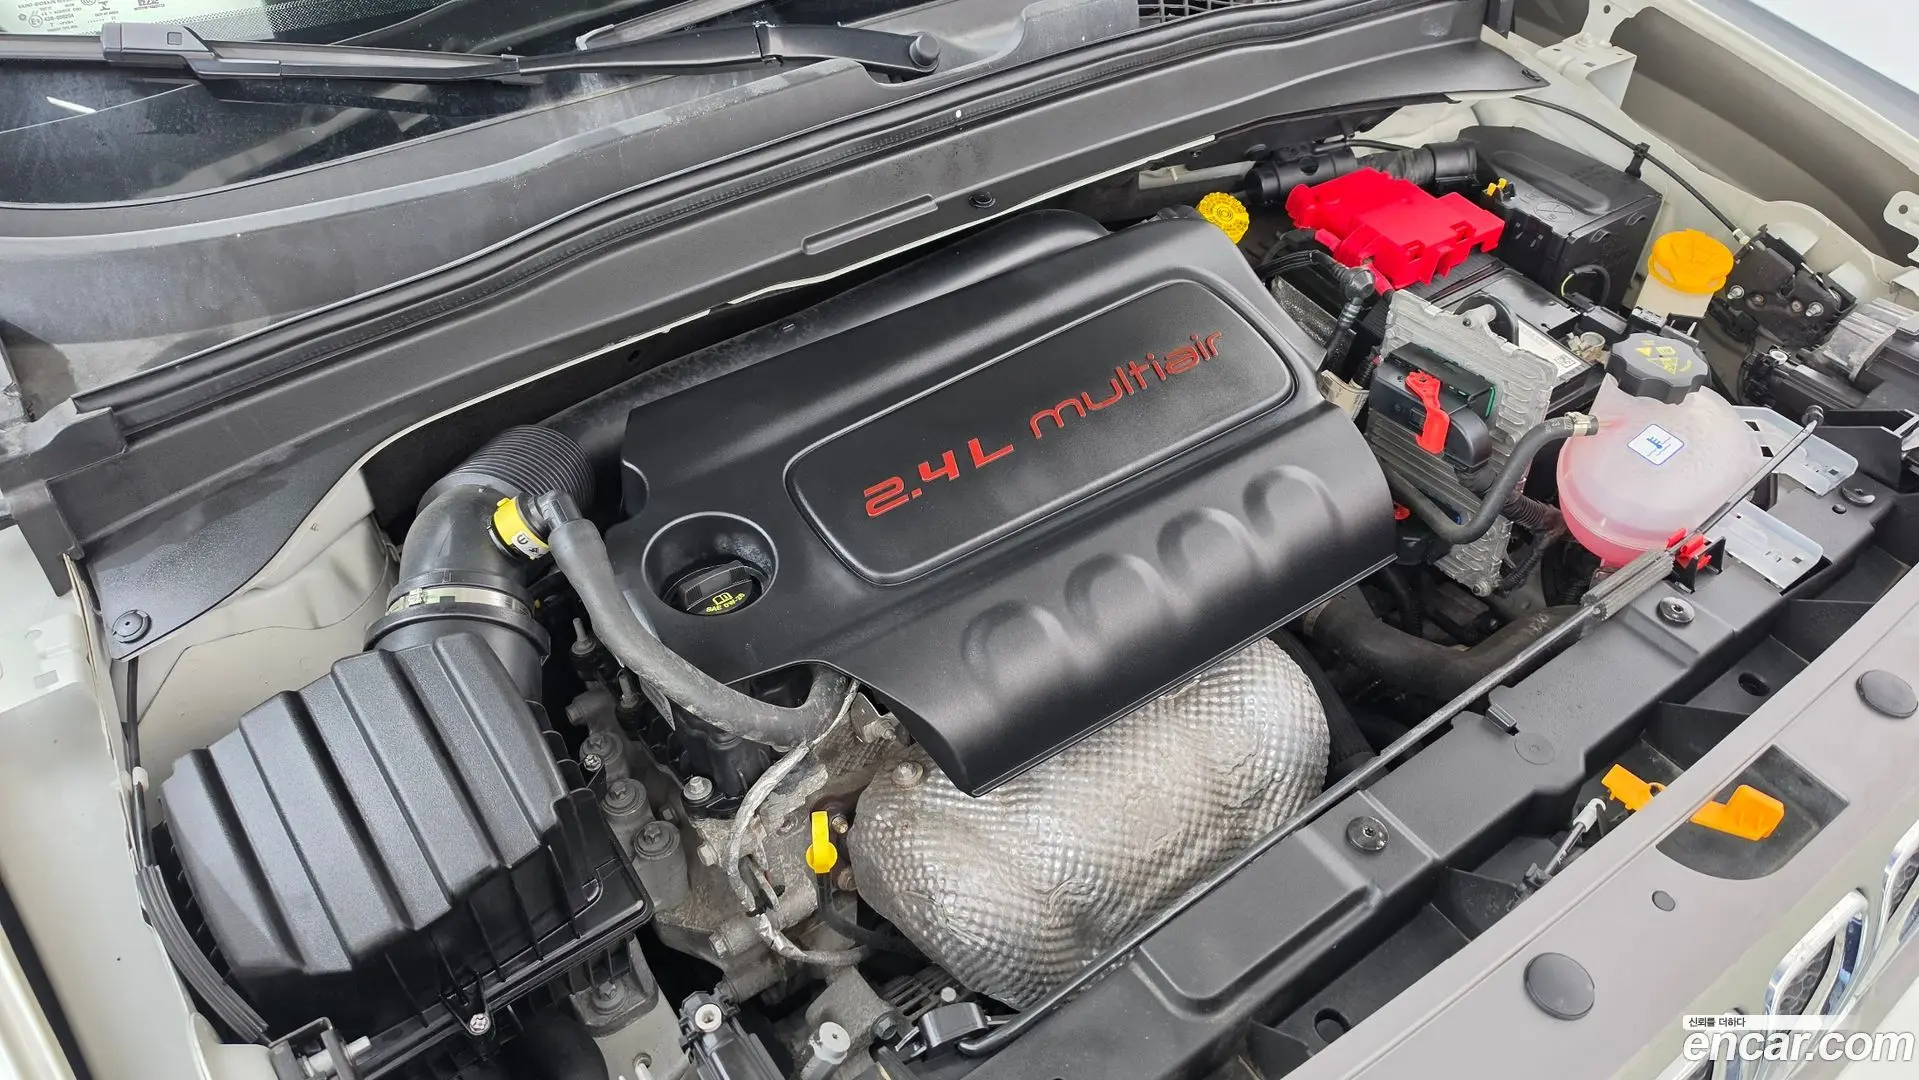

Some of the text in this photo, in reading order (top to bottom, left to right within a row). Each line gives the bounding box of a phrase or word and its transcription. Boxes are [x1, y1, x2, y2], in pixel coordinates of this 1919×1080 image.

[864, 331, 1222, 517] 2.4 L multiair
